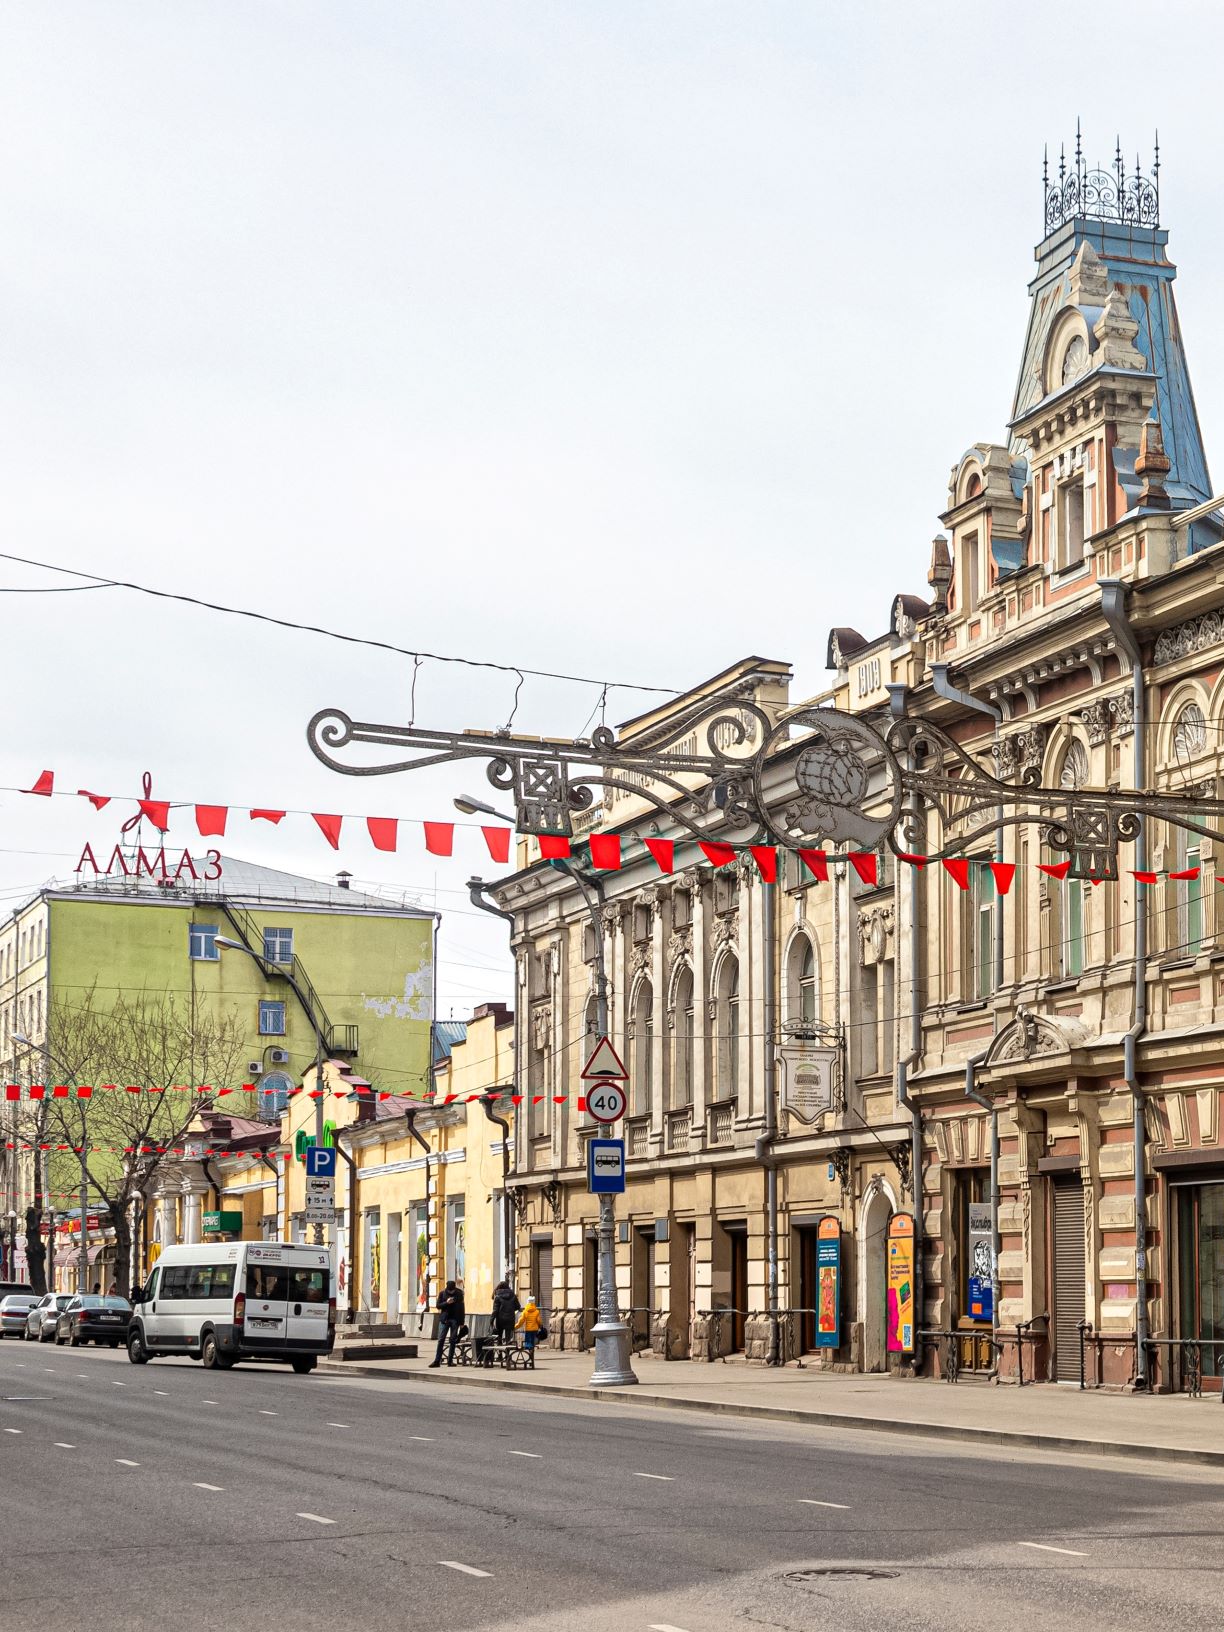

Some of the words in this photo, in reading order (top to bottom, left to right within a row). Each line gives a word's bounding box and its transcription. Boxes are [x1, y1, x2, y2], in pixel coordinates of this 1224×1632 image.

[73, 841, 223, 881] АЛМАЗ
[594, 1095, 618, 1111] 40
[314, 1151, 331, 1173] P
